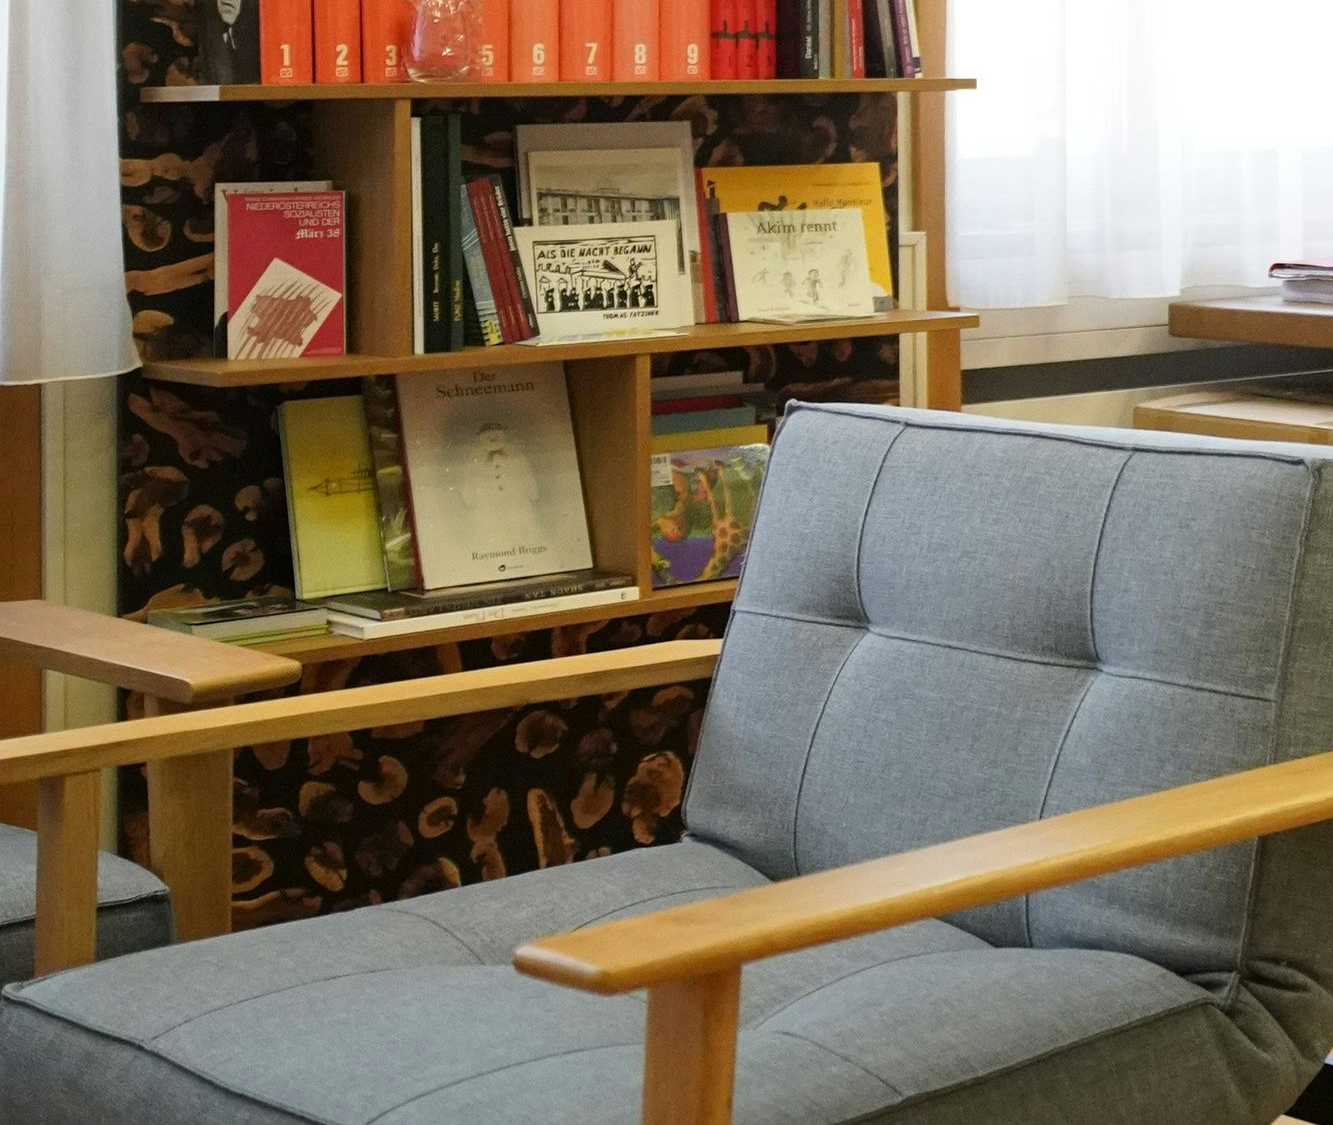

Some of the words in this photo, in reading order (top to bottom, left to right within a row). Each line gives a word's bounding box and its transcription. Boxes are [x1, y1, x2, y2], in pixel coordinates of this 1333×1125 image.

[280, 44, 291, 66] 1
[336, 44, 348, 66] 2
[385, 45, 397, 66] 3
[481, 44, 494, 65] 5
[532, 43, 545, 64] 6
[585, 43, 598, 64] 7
[634, 43, 647, 64] 8
[687, 43, 698, 64] 9
[284, 210, 340, 219] SOZIALISTEN
[299, 218, 319, 226] UND
[321, 218, 340, 226] DER
[327, 228, 340, 238] 38
[757, 221, 796, 234] Akim
[801, 221, 838, 233] rennt
[537, 249, 557, 259] ALS
[560, 247, 576, 258] DIE
[579, 246, 611, 257] NACHT
[613, 244, 652, 255] BEGANN
[473, 371, 496, 383] Der
[436, 380, 535, 399] Schneemann
[471, 548, 516, 562] Raymond
